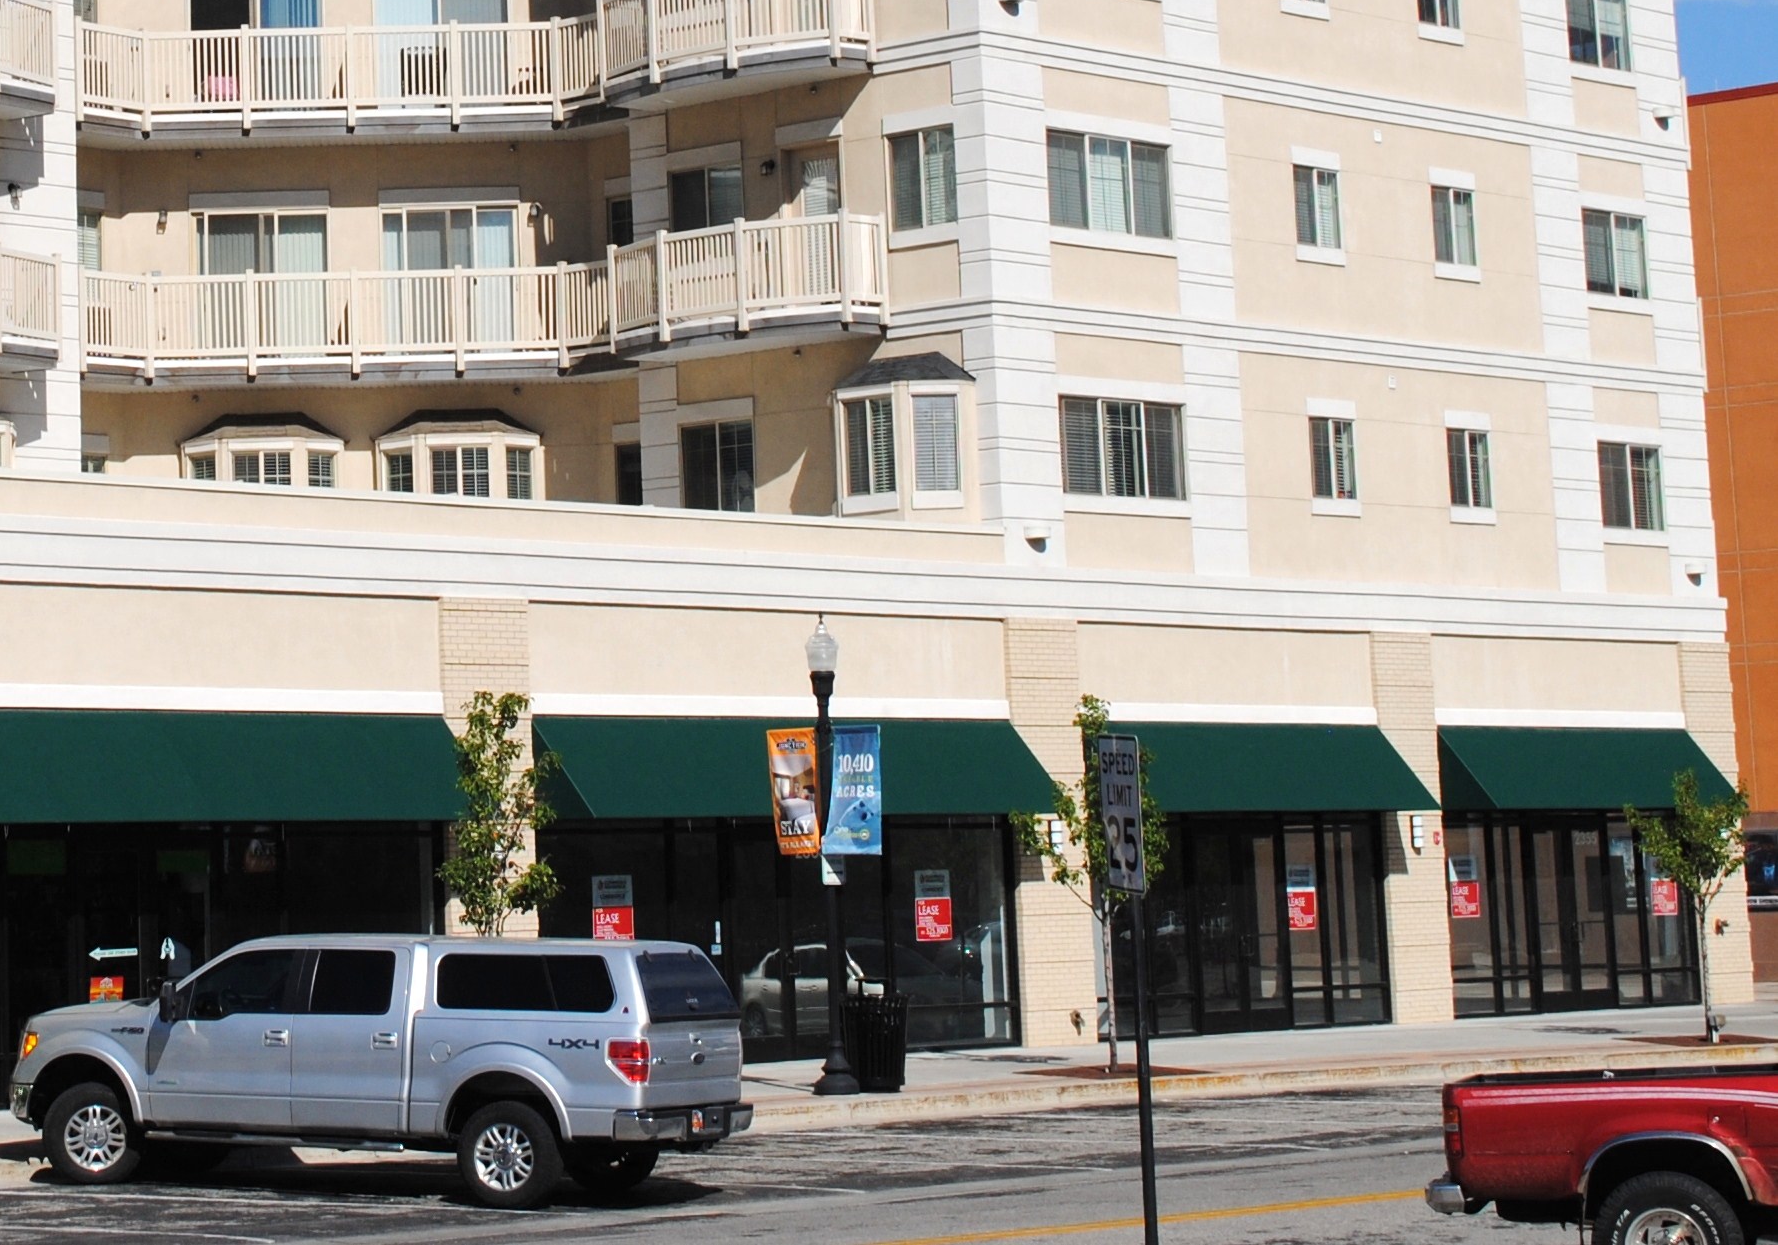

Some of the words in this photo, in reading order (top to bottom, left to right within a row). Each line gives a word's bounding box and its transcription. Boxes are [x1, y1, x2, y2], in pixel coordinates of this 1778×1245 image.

[838, 753, 874, 775] 10,410
[1102, 751, 1135, 776] SPEED
[836, 785, 875, 798] ACRES
[1107, 783, 1132, 807] LIMIT
[781, 819, 811, 835] STAY
[1107, 815, 1138, 872] 25
[595, 913, 620, 924] LEASE
[918, 905, 940, 916] LEASE
